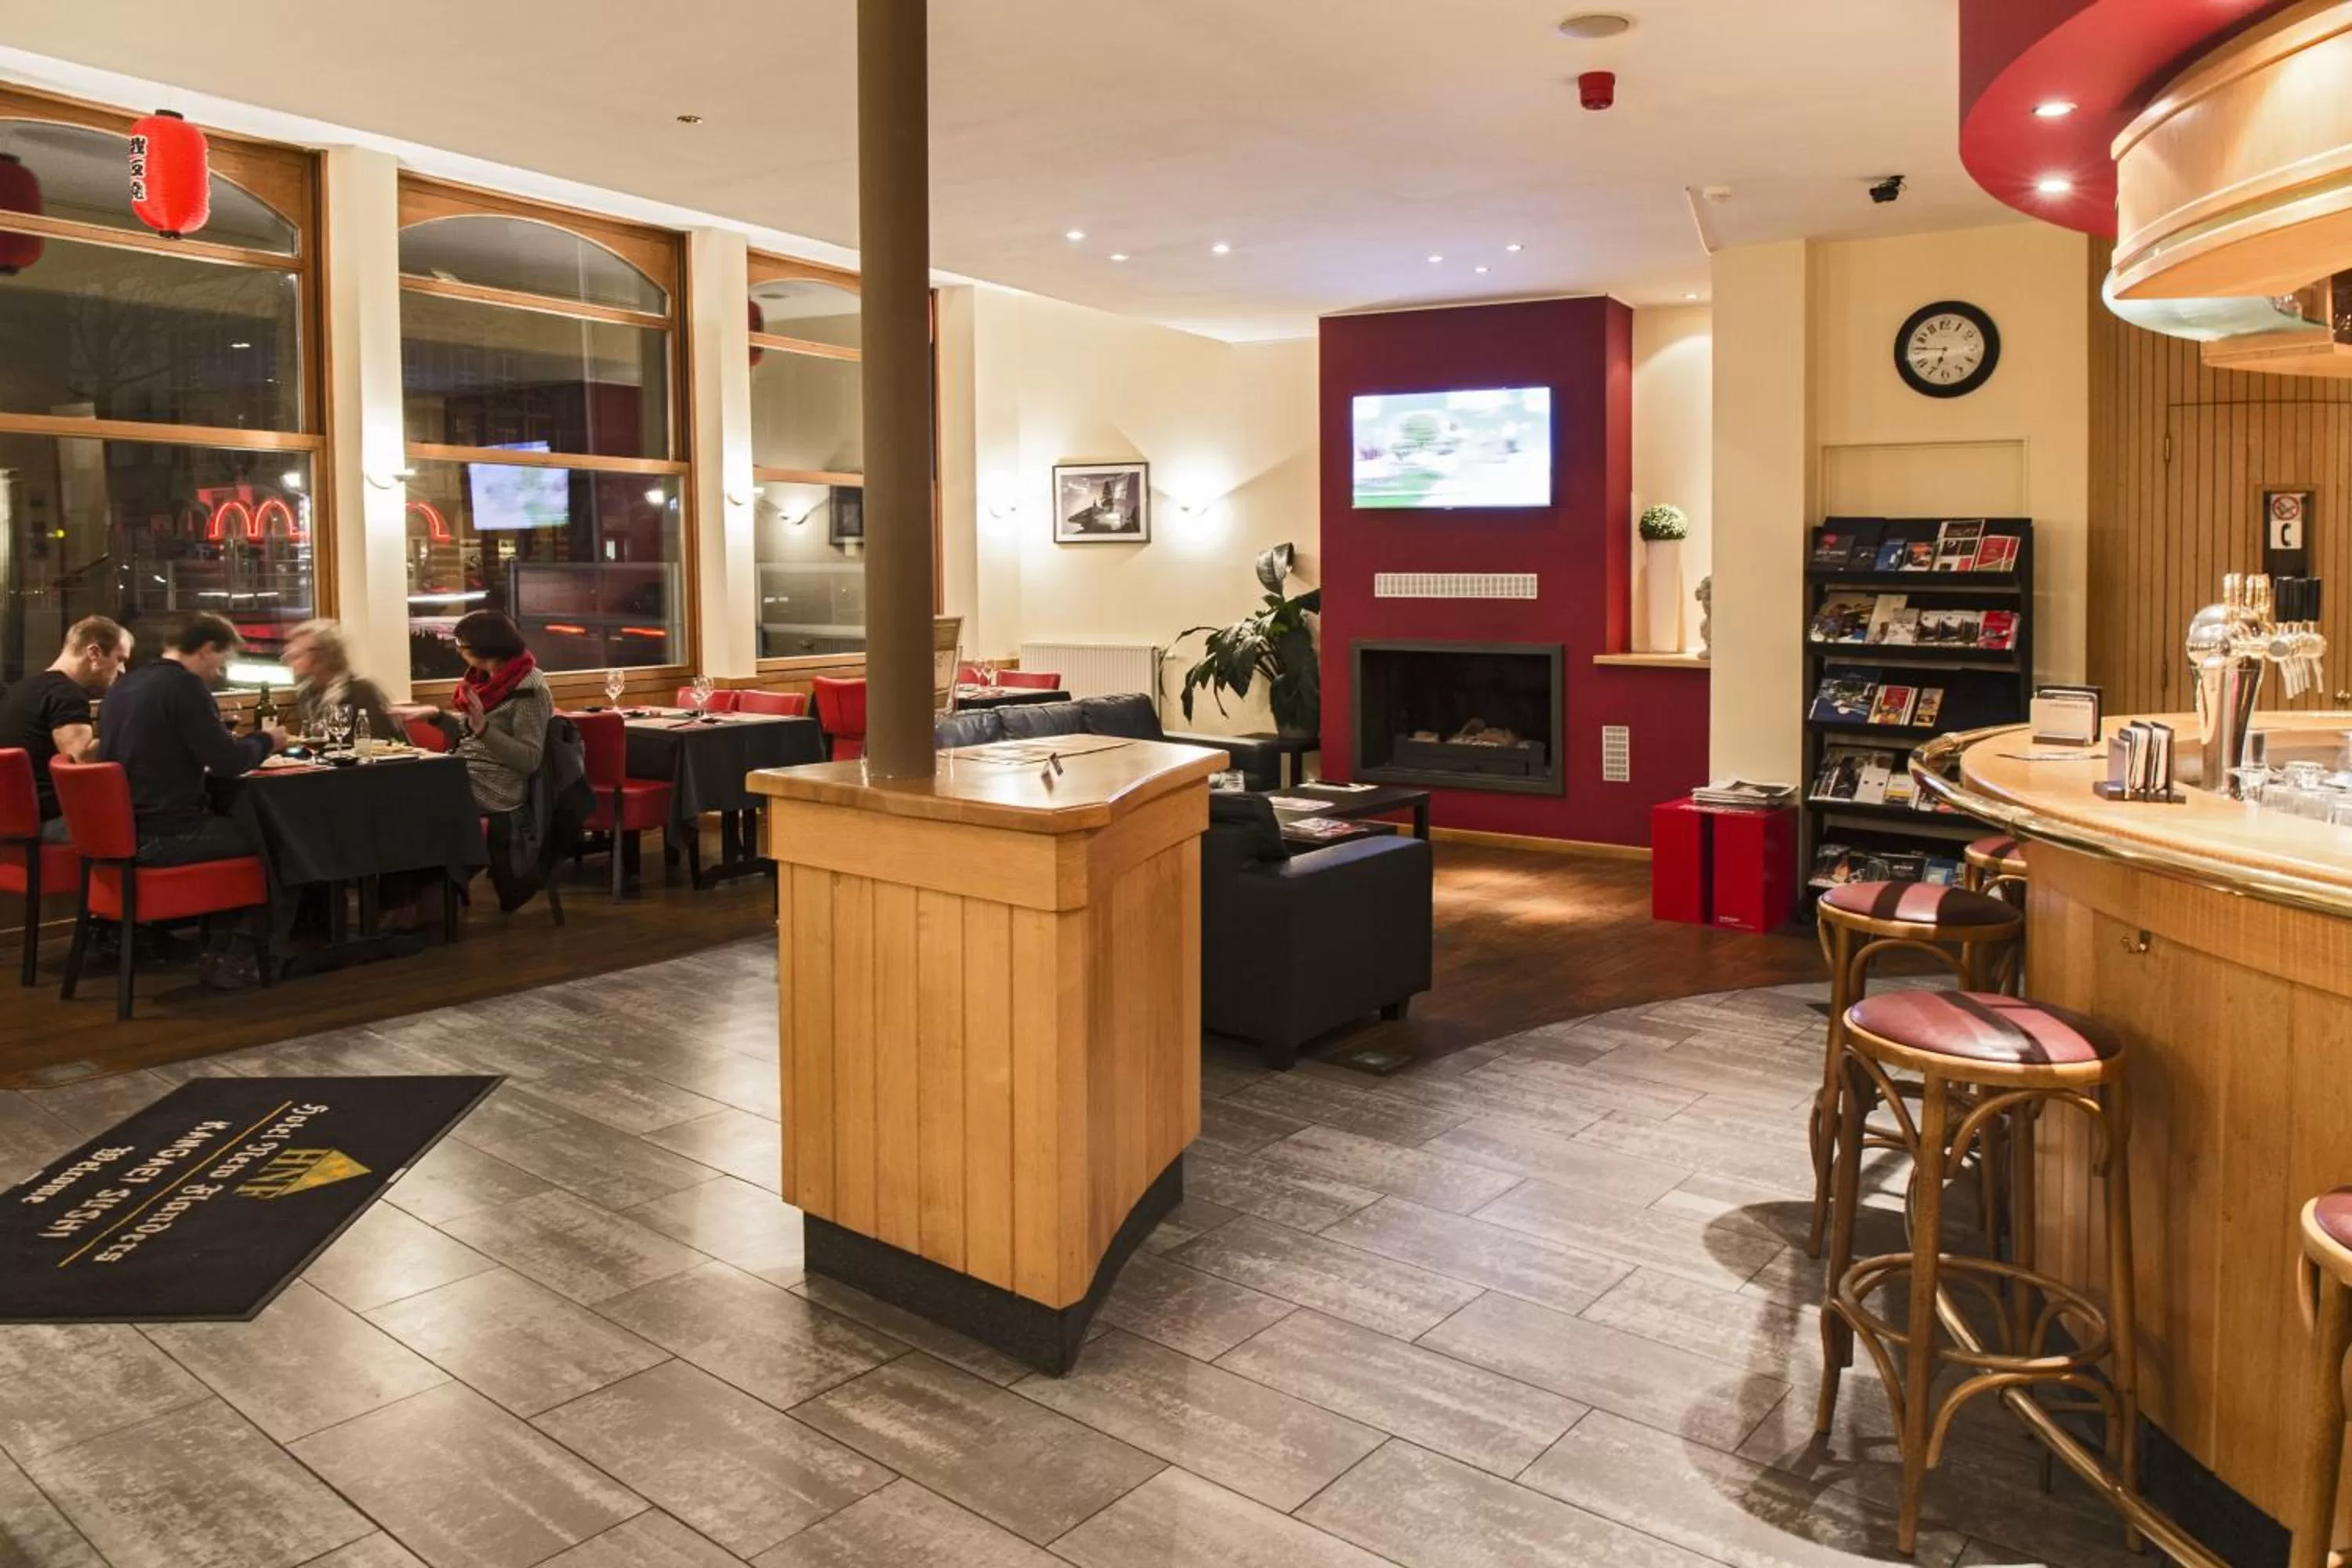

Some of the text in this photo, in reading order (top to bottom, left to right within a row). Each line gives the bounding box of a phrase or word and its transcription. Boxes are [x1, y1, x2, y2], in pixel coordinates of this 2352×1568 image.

[1940, 319, 1951, 330] 12
[20, 1145, 135, 1203] Welcome
[37, 1120, 232, 1238] KANGAEI SUSHI
[93, 1103, 329, 1262] Hotel New Flanders
[235, 1148, 322, 1198] HNF
